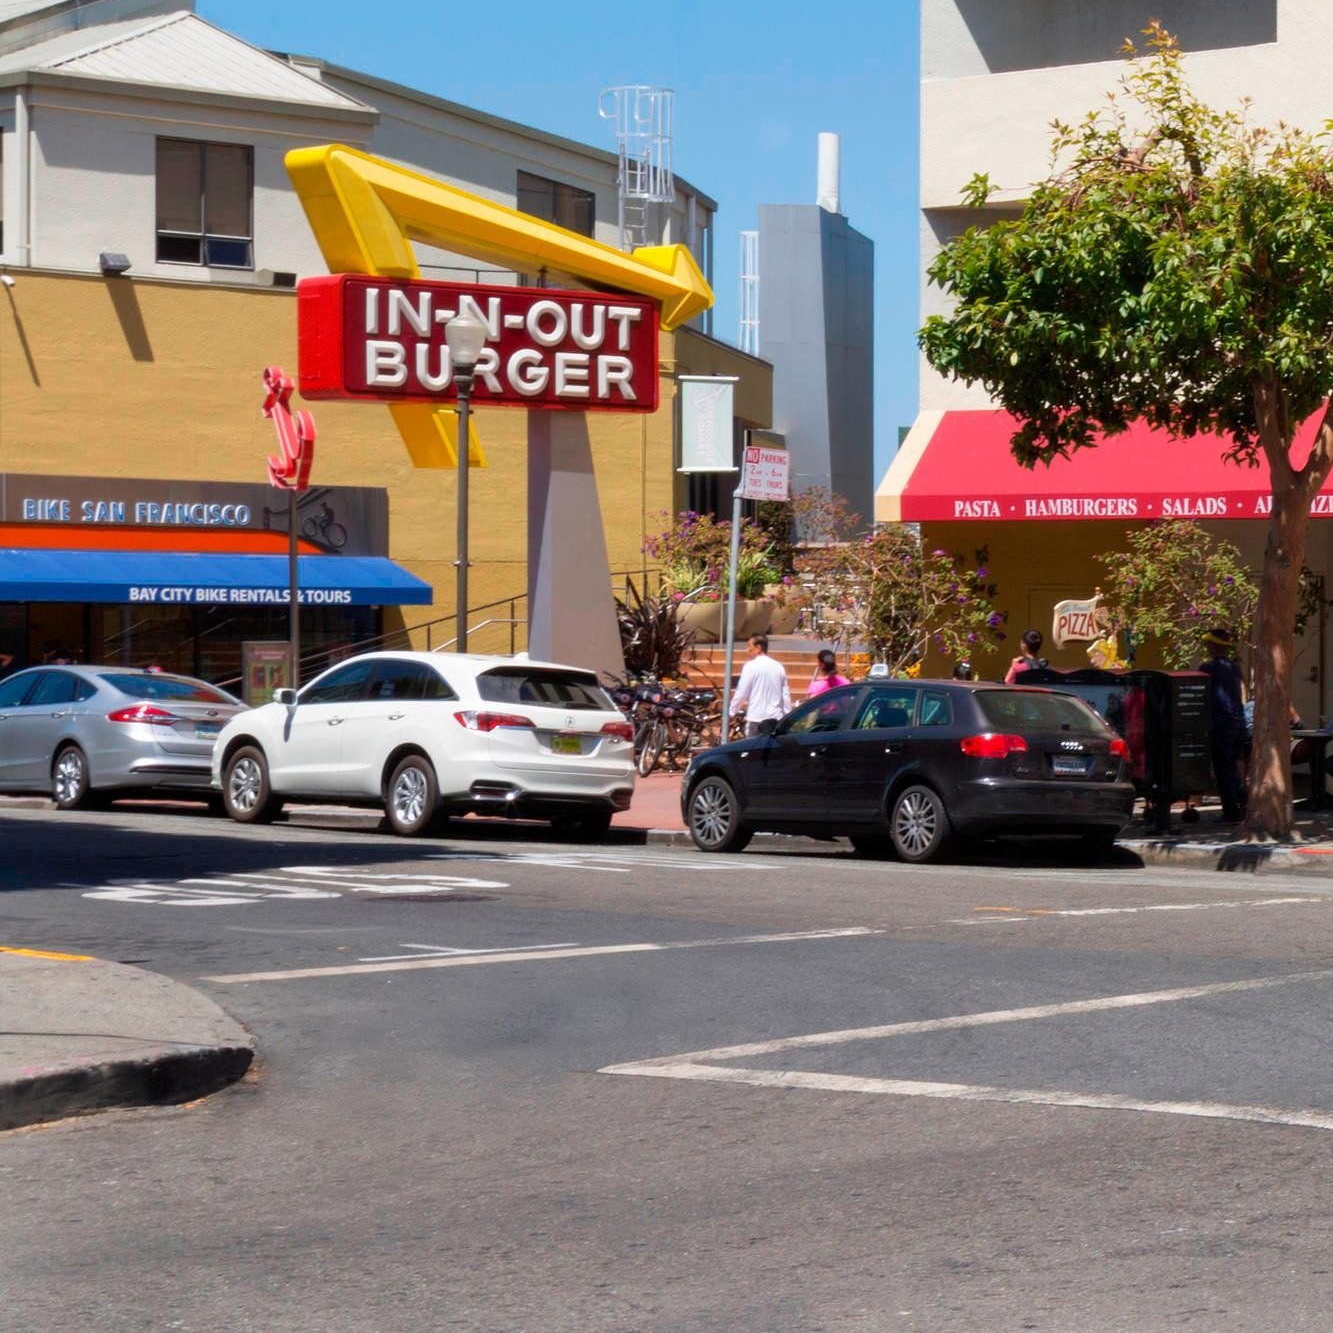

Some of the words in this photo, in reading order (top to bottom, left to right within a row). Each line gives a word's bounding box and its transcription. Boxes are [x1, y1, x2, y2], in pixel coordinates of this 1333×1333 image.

[365, 287, 642, 352] IN-N-OUT
[365, 340, 638, 401] BURGER
[23, 498, 71, 522] BIKE
[82, 500, 125, 523] SAN
[135, 502, 251, 526] FRANCISCO
[954, 500, 1000, 517] PASTA
[1025, 498, 1137, 516] HAMBURGERS
[1162, 497, 1227, 515] SALADS
[129, 587, 157, 601] BAY
[161, 587, 193, 602] CITY
[196, 588, 228, 602] BIKE
[230, 589, 291, 604] RENTALS
[305, 590, 352, 603] TOURS
[1058, 612, 1096, 639] PIZZA
